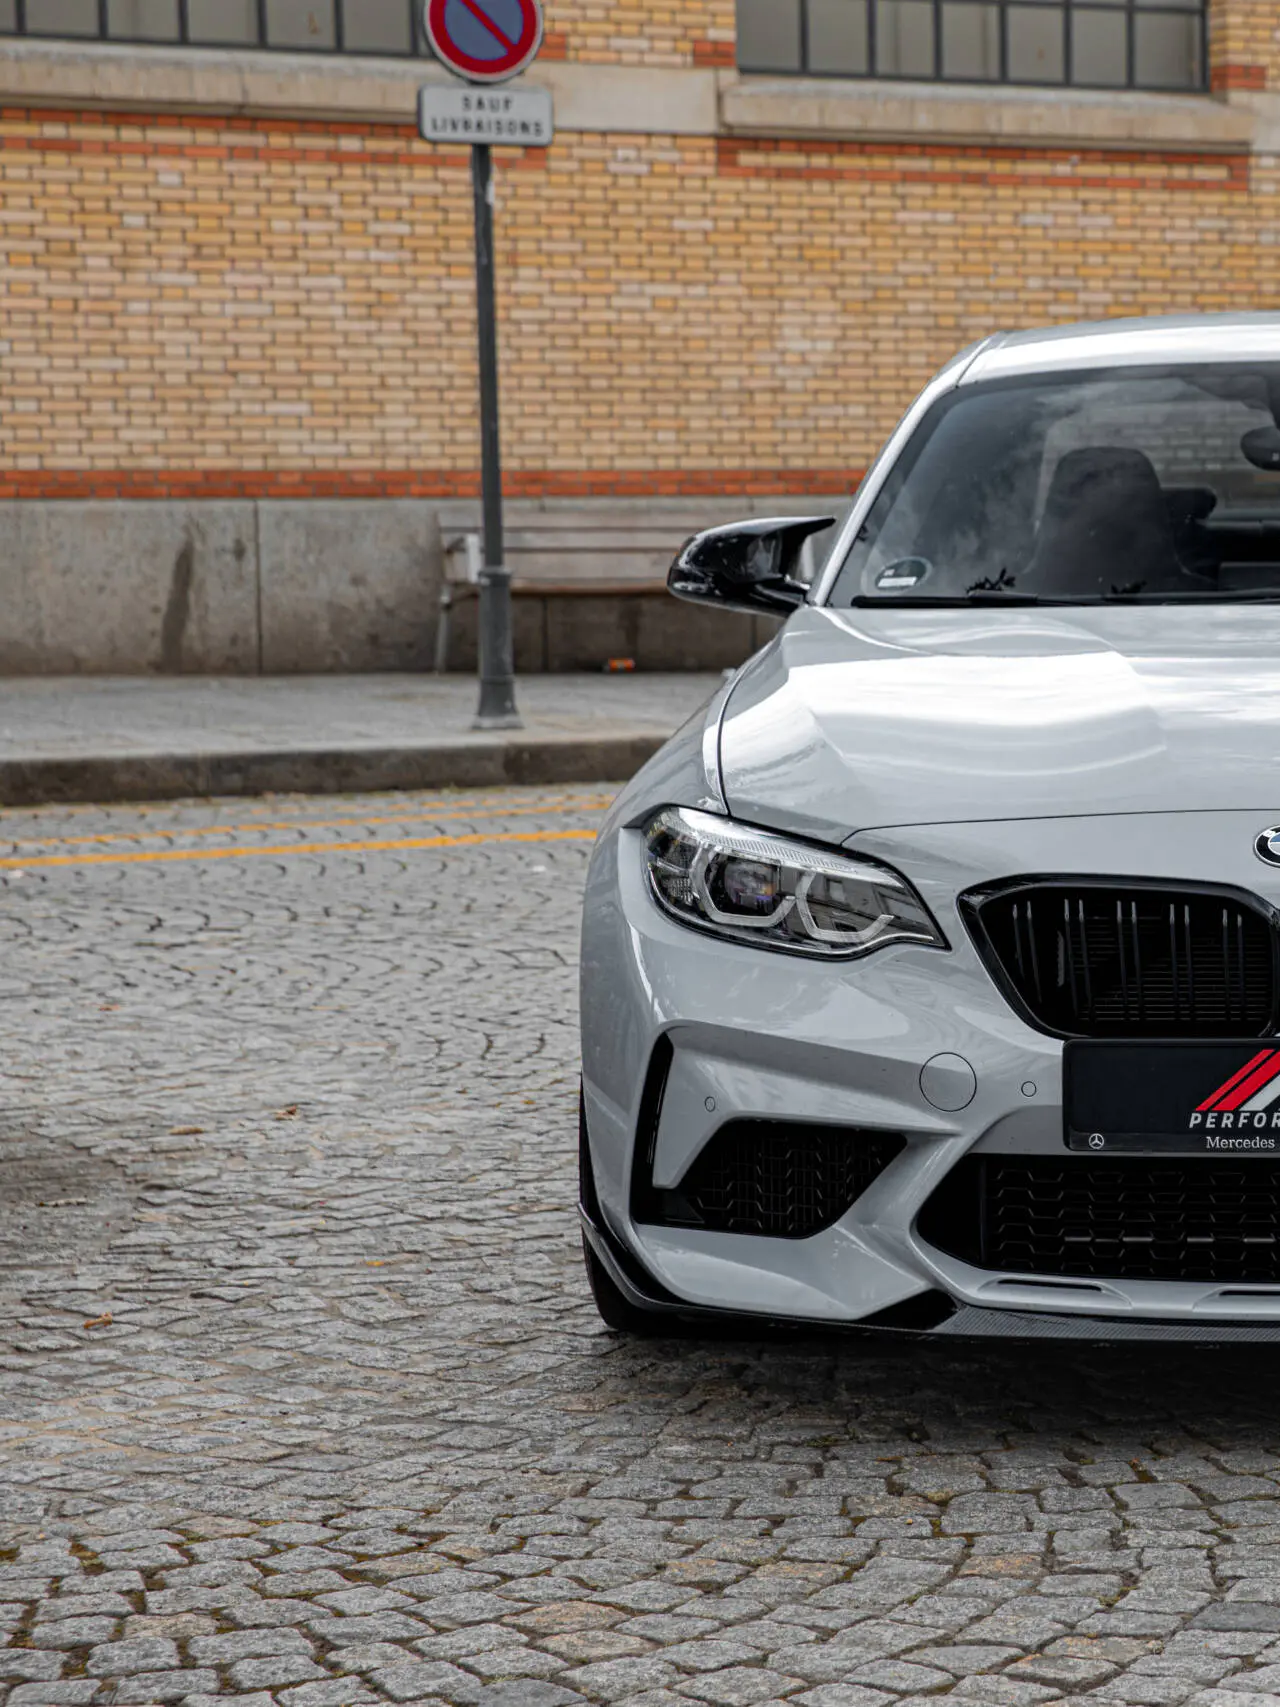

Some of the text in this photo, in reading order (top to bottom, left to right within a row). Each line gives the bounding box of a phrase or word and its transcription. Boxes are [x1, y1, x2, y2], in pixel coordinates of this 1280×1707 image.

[462, 94, 513, 112] SAUF
[430, 116, 544, 137] LIVRAISONS
[1206, 1136, 1275, 1149] Mercedes
